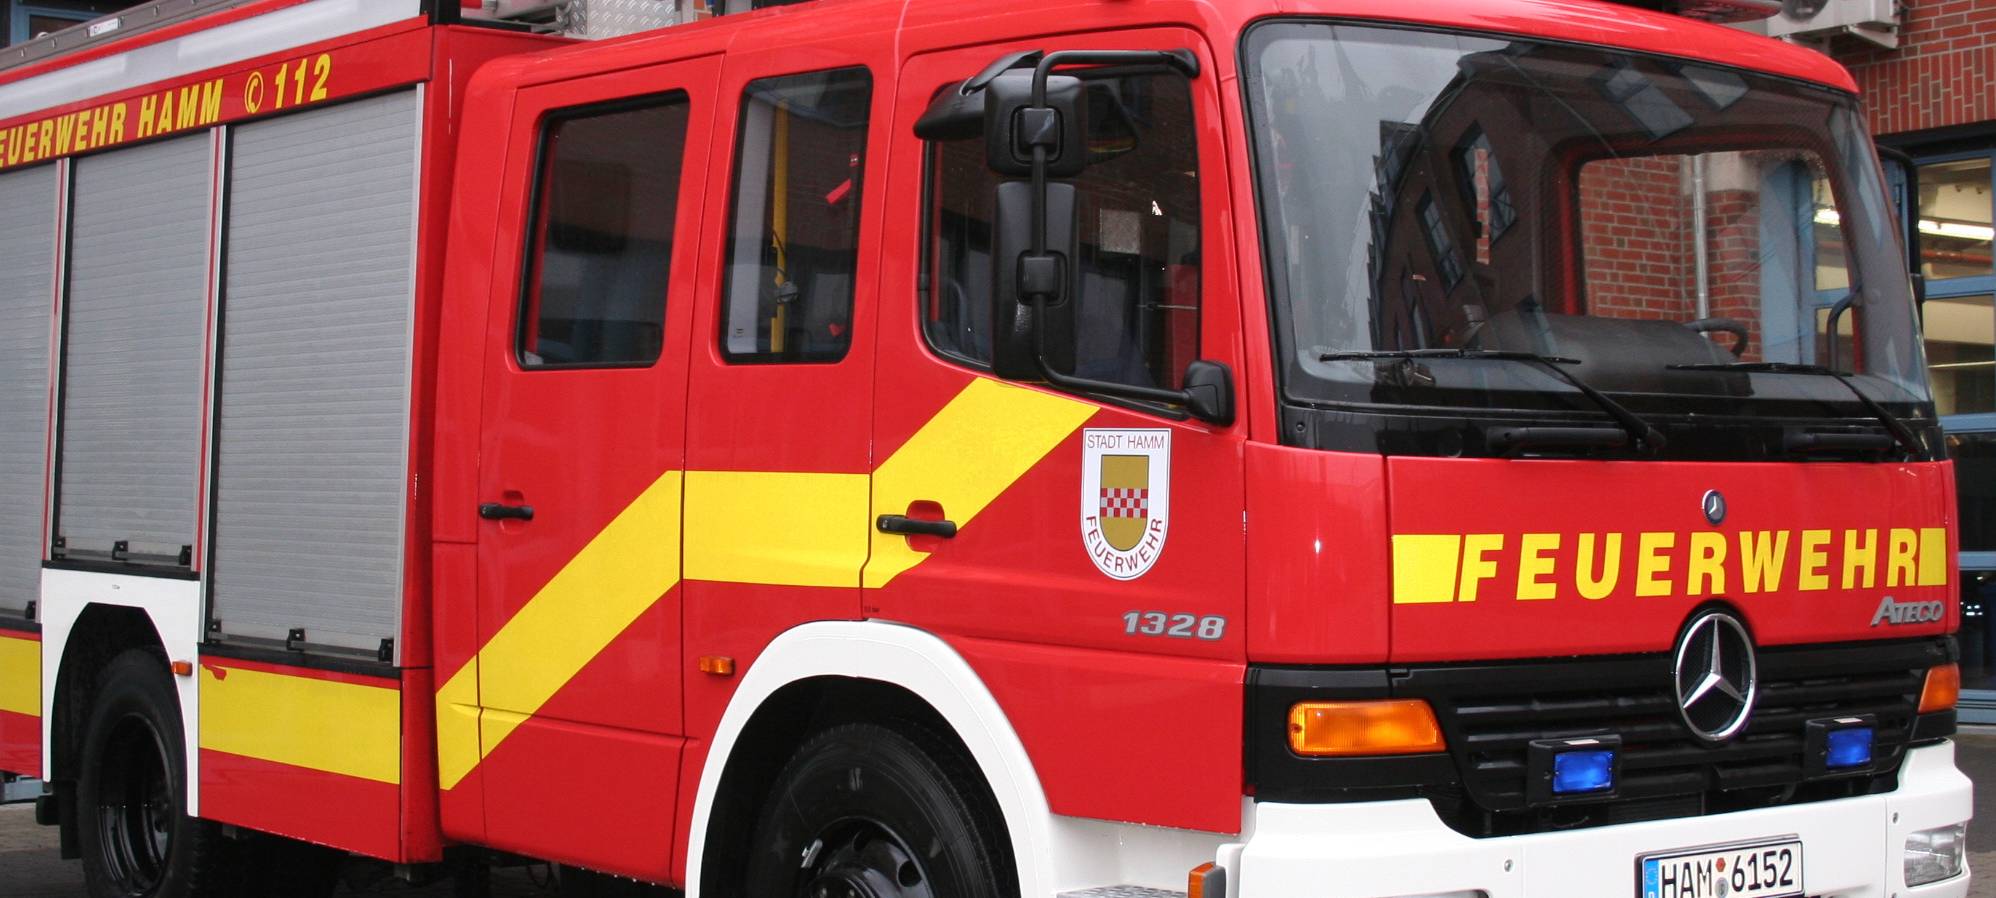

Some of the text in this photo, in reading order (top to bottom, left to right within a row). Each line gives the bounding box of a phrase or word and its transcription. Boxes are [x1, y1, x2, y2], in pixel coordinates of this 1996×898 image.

[137, 80, 223, 138] HAMM
[275, 53, 331, 109] 112
[1087, 435, 1165, 449] STADT HAMM
[1086, 516, 1162, 573] FEUERWEHR
[1459, 528, 1917, 602] FEUERWEHR
[1122, 611, 1226, 640] 1328
[1731, 848, 1793, 892] 6152
